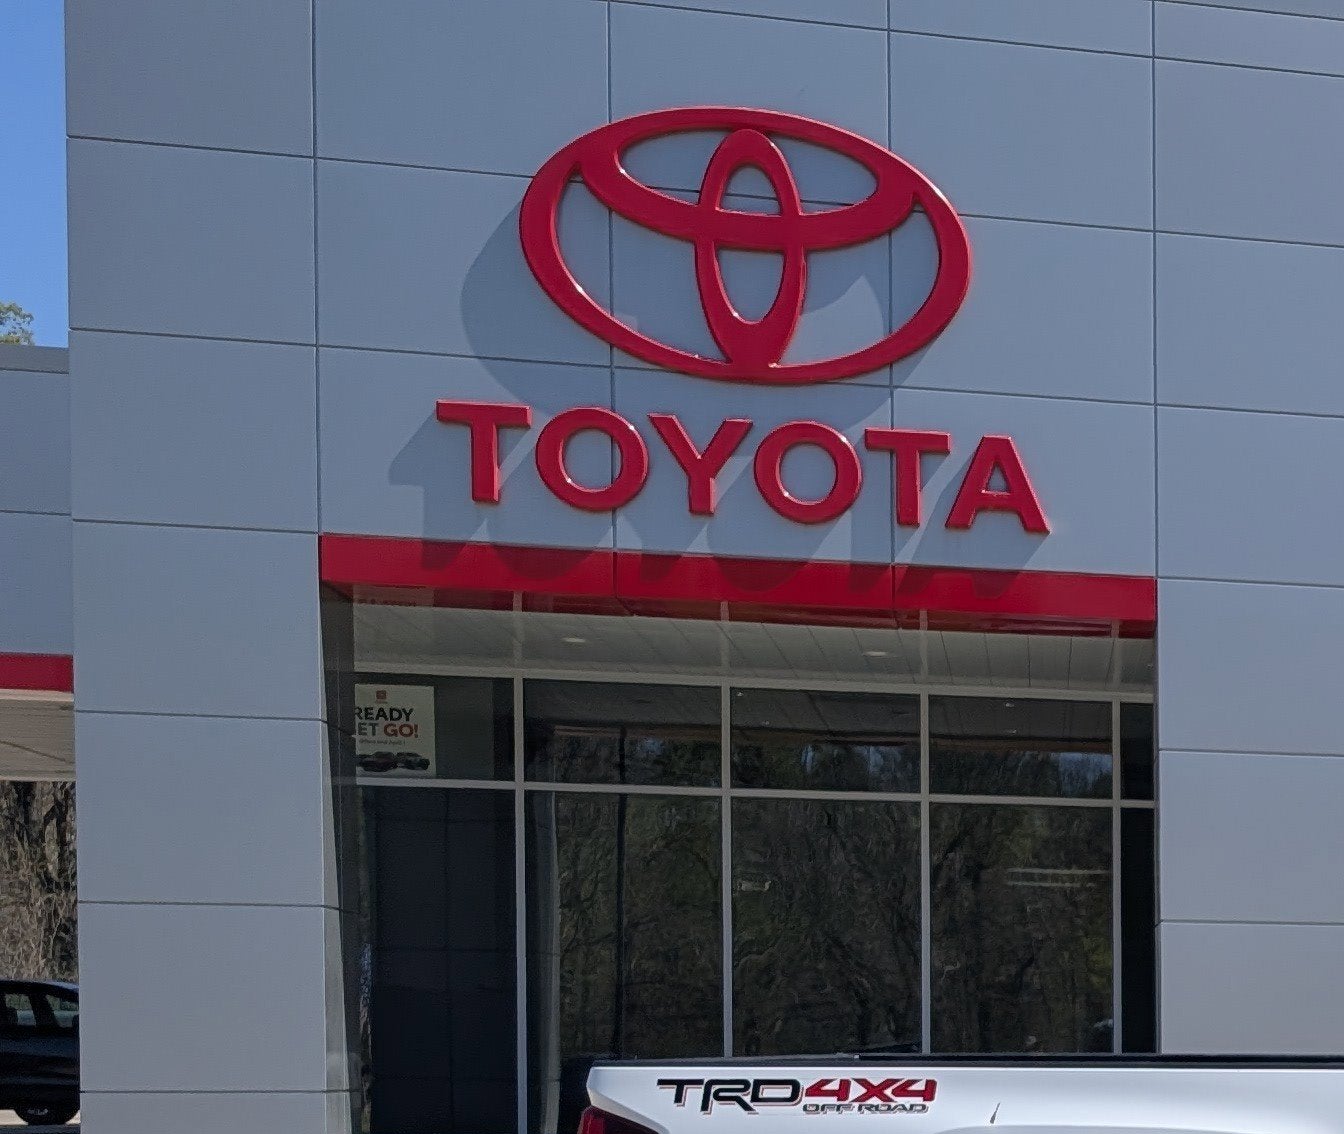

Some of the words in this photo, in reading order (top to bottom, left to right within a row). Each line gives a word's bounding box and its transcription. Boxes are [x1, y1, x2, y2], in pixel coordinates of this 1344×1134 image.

[436, 398, 1051, 534] TOYOTA
[354, 706, 414, 721] READY
[357, 722, 379, 736] ET
[383, 723, 419, 738] GO!
[657, 1078, 803, 1114] TRD
[803, 1078, 938, 1104] 4X4
[802, 1103, 854, 1114] OFF
[857, 1103, 930, 1114] ROAD
